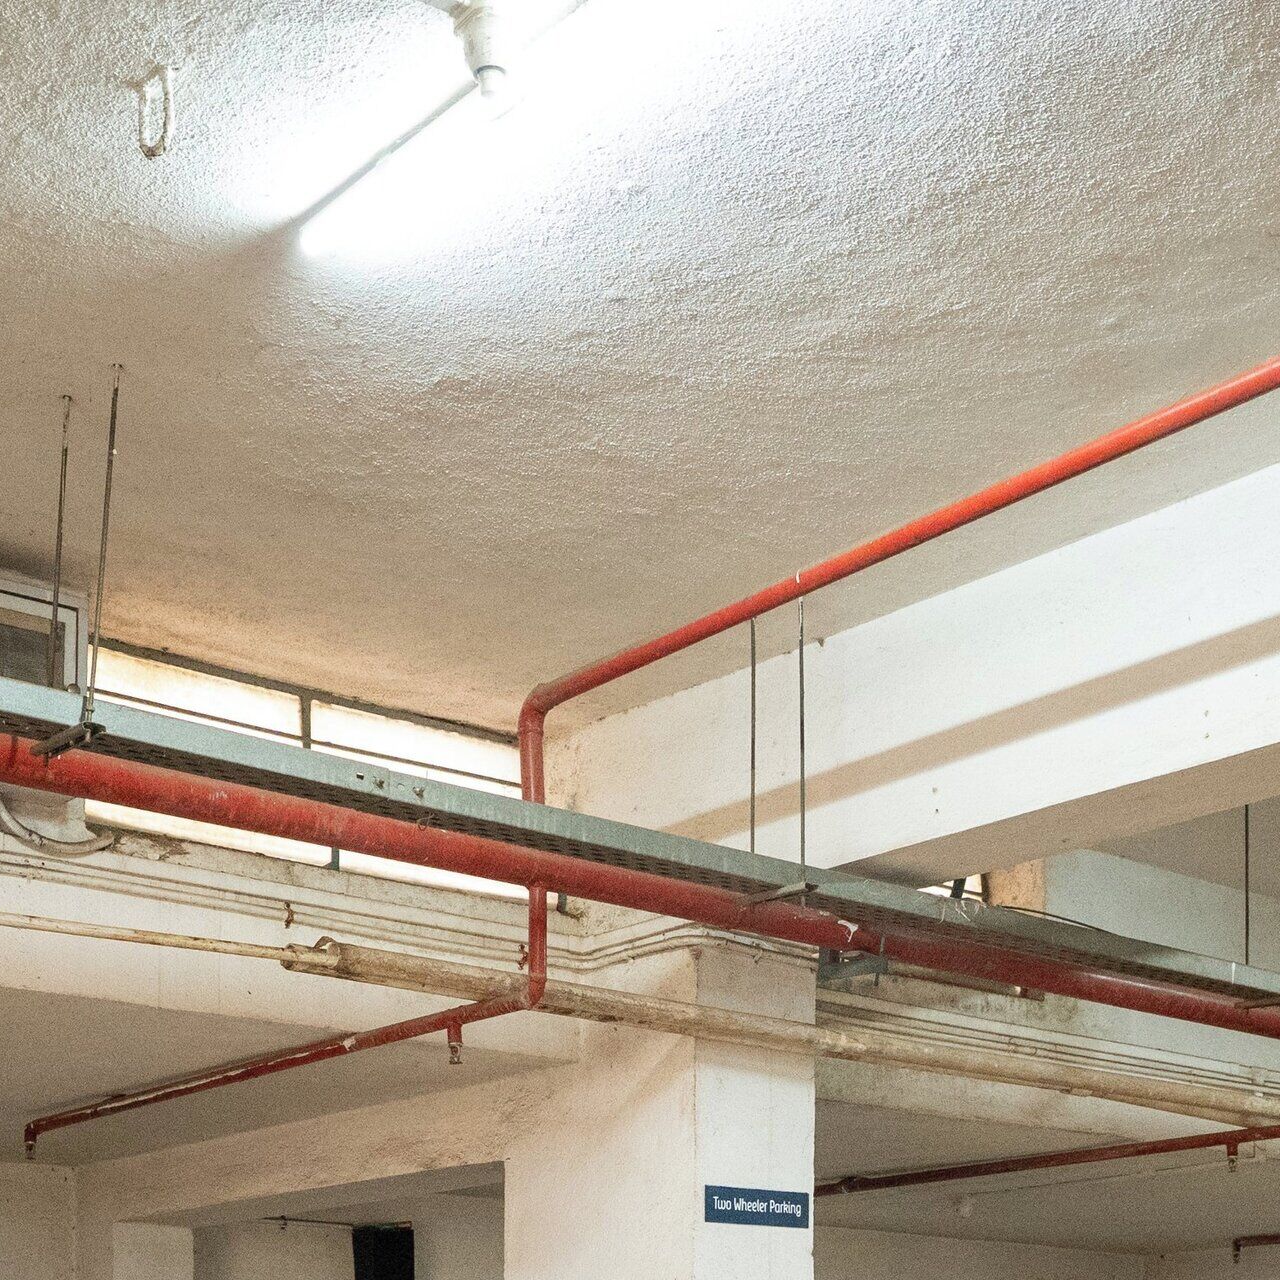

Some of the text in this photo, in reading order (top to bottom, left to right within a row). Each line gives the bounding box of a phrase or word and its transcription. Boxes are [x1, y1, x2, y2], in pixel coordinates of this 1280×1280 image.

[713, 1196, 802, 1218] Two Wheeler Parking
